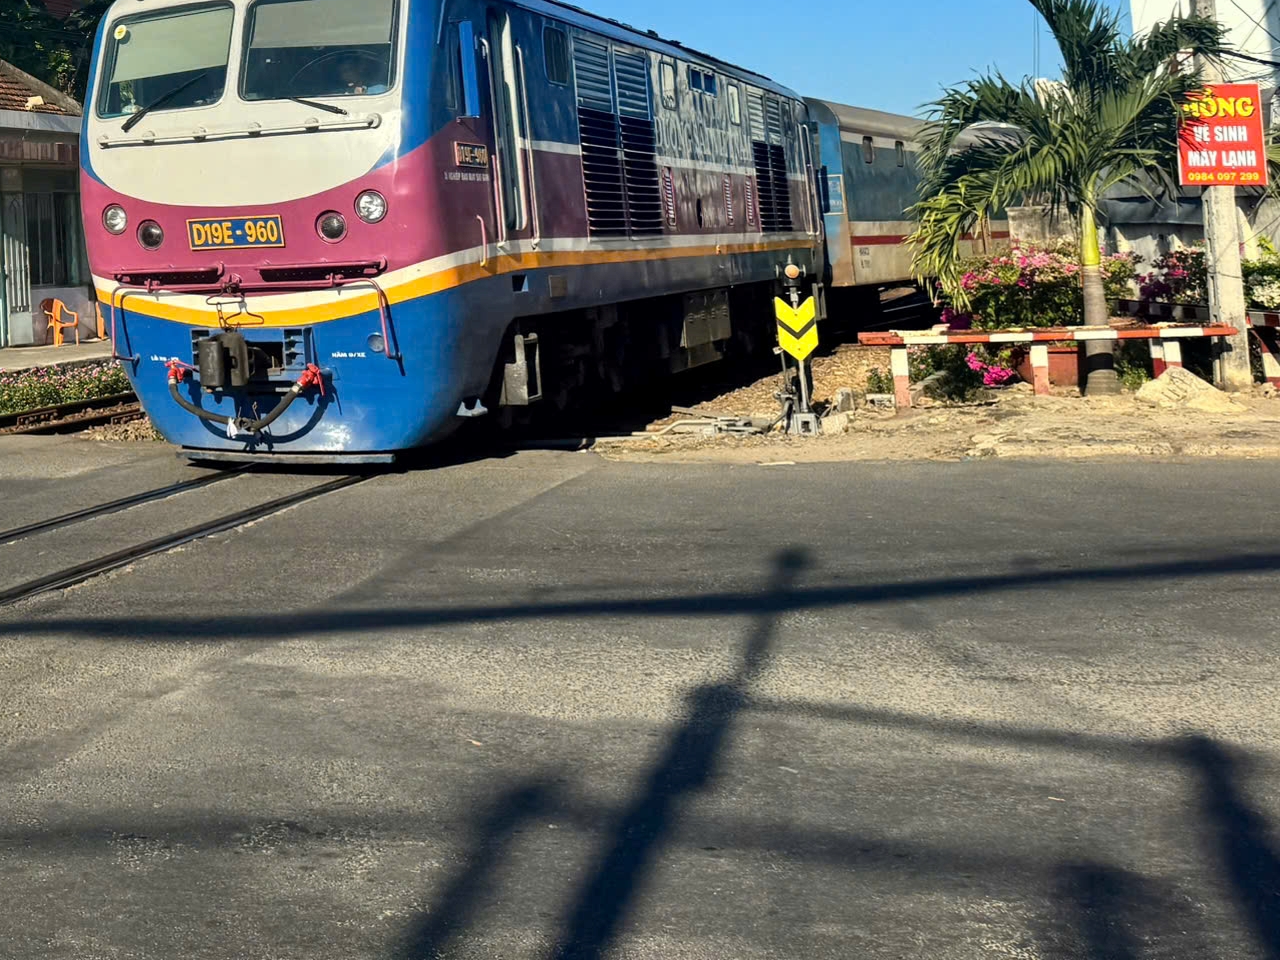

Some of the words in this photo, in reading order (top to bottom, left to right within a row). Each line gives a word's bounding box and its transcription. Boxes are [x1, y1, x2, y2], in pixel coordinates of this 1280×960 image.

[1214, 125, 1248, 142] SINH
[1221, 150, 1257, 169] LẠNH
[1187, 172, 1214, 181] 0984
[1217, 172, 1236, 181] 097
[1240, 172, 1260, 181] 299
